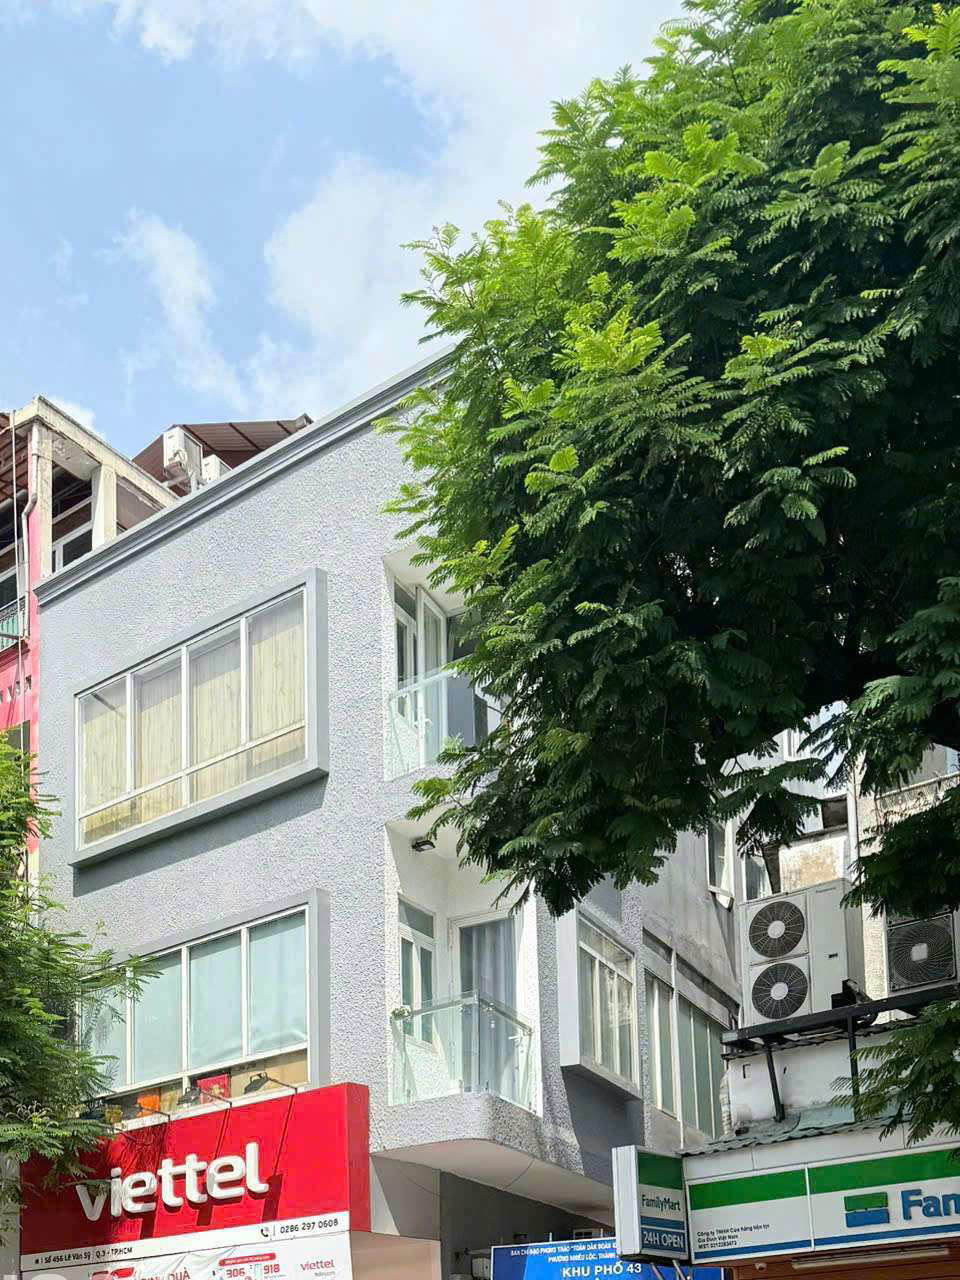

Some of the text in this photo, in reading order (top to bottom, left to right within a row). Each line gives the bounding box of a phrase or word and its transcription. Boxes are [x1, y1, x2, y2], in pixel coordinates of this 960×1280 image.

[75, 1141, 269, 1222] viettel
[641, 1194, 681, 1212] FamilyMart
[280, 1218, 339, 1234] 0286 297 0608
[643, 1230, 684, 1248] 24H OPEN
[226, 1267, 246, 1279] 306
[263, 1263, 281, 1275] 918
[300, 1259, 335, 1272] viettel
[562, 1260, 642, 1278] KHU PHỐ 43
